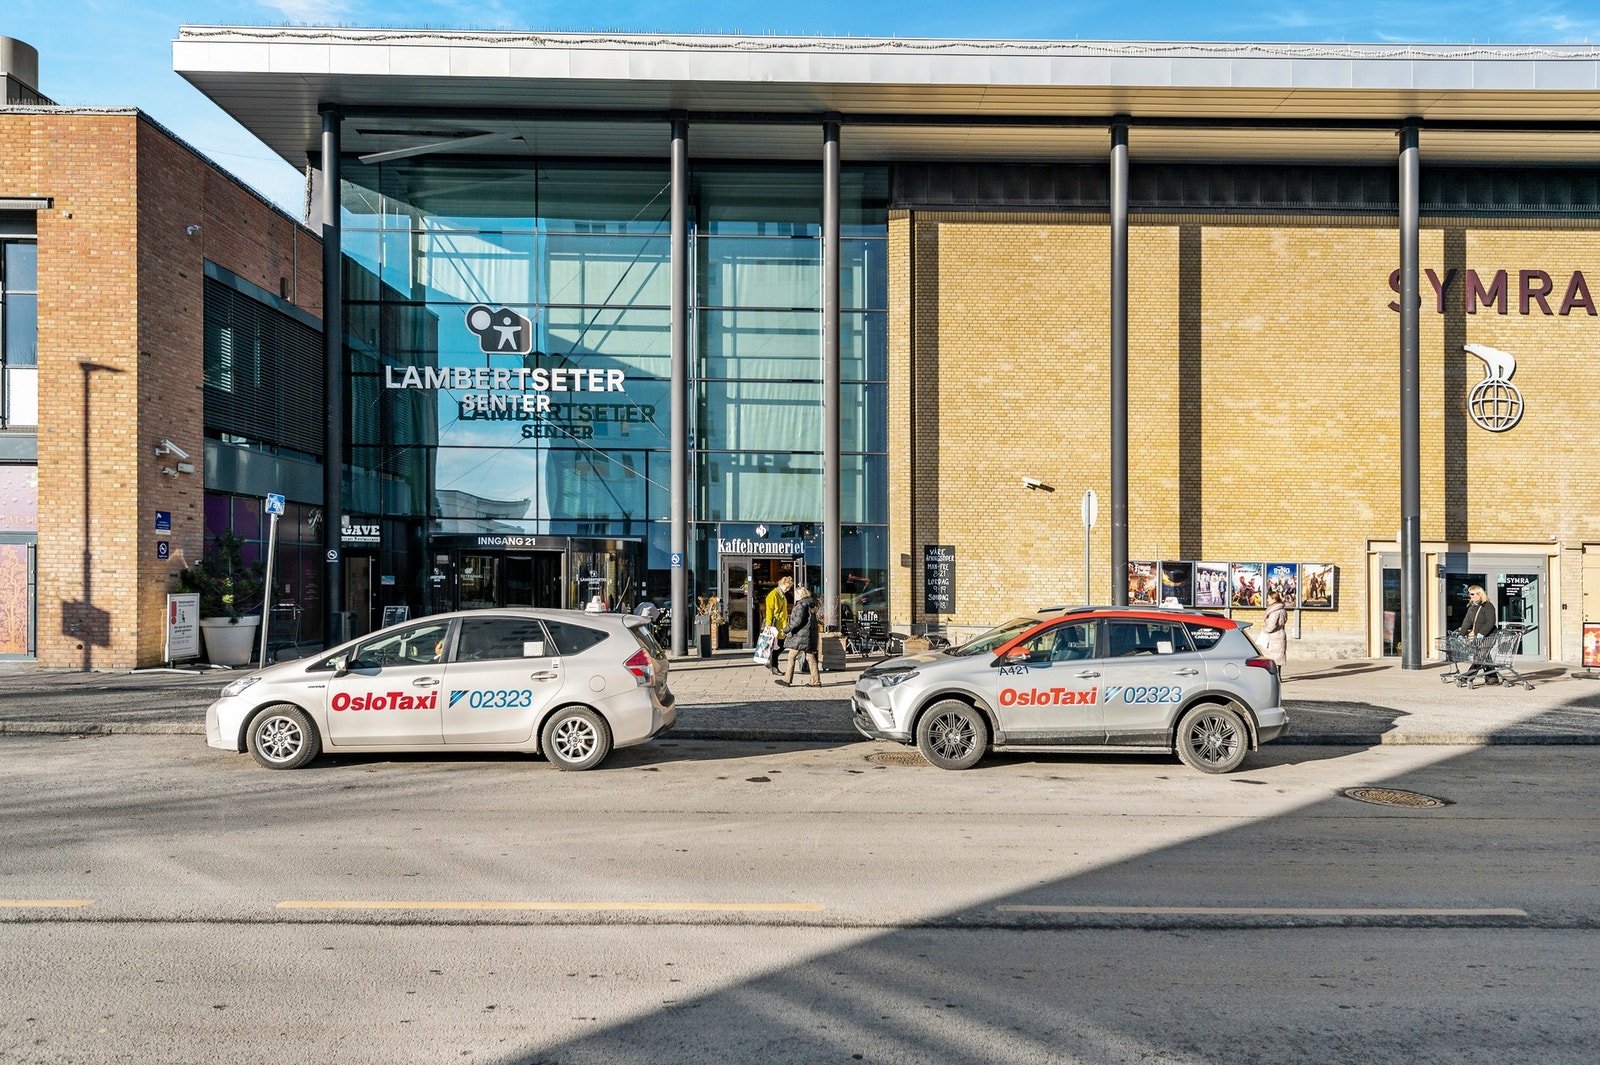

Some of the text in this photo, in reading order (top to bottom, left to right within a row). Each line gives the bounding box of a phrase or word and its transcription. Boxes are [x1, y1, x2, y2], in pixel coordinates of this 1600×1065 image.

[385, 365, 626, 392] LAMBERTSETER
[462, 394, 551, 413] SENTER
[477, 536, 536, 546] INNGANG 21
[717, 538, 805, 554] Kaffebrenneriet
[857, 610, 879, 621] Kaffe
[999, 665, 1030, 676] A421
[331, 690, 533, 712] OsloTaxi 02323
[999, 686, 1182, 707] OsloTaxi 02323
